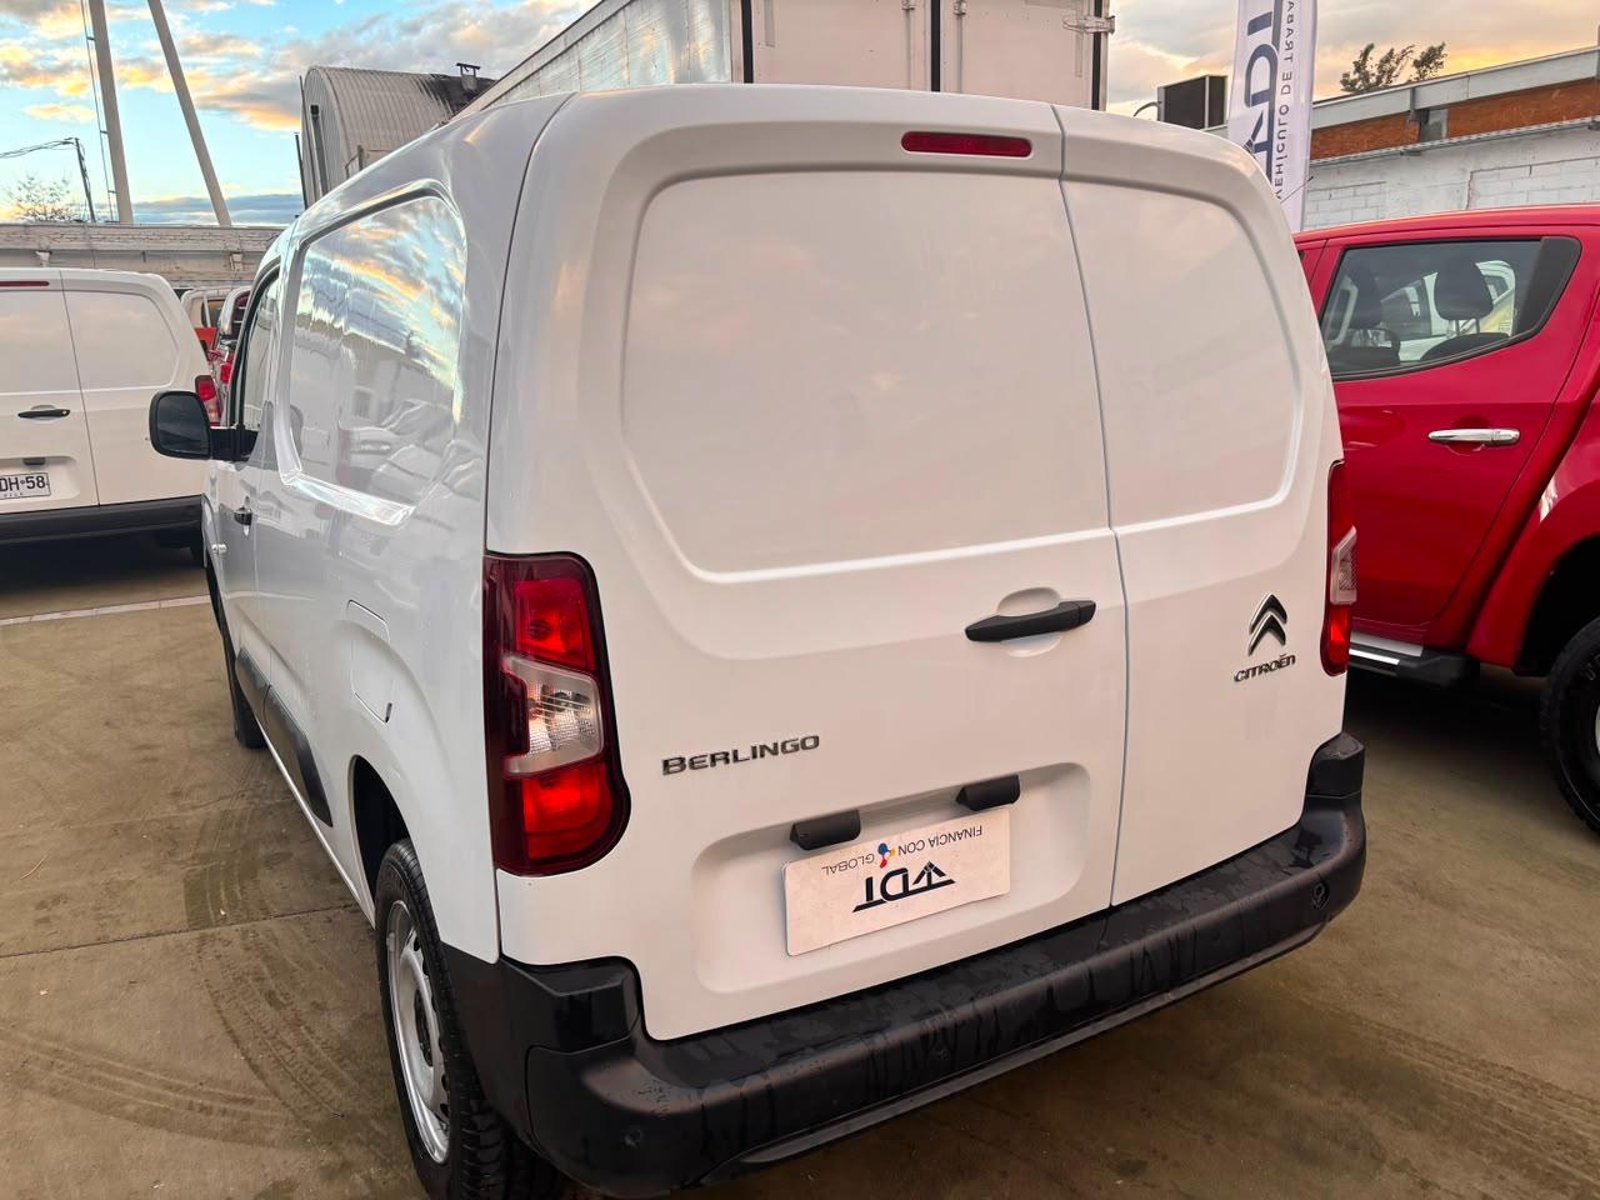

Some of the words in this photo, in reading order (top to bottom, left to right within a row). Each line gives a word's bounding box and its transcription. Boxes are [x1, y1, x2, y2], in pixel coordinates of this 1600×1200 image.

[898, 840, 926, 856] CON
[928, 825, 983, 848] FINANCIA
[821, 853, 875, 876] GLOBAL
